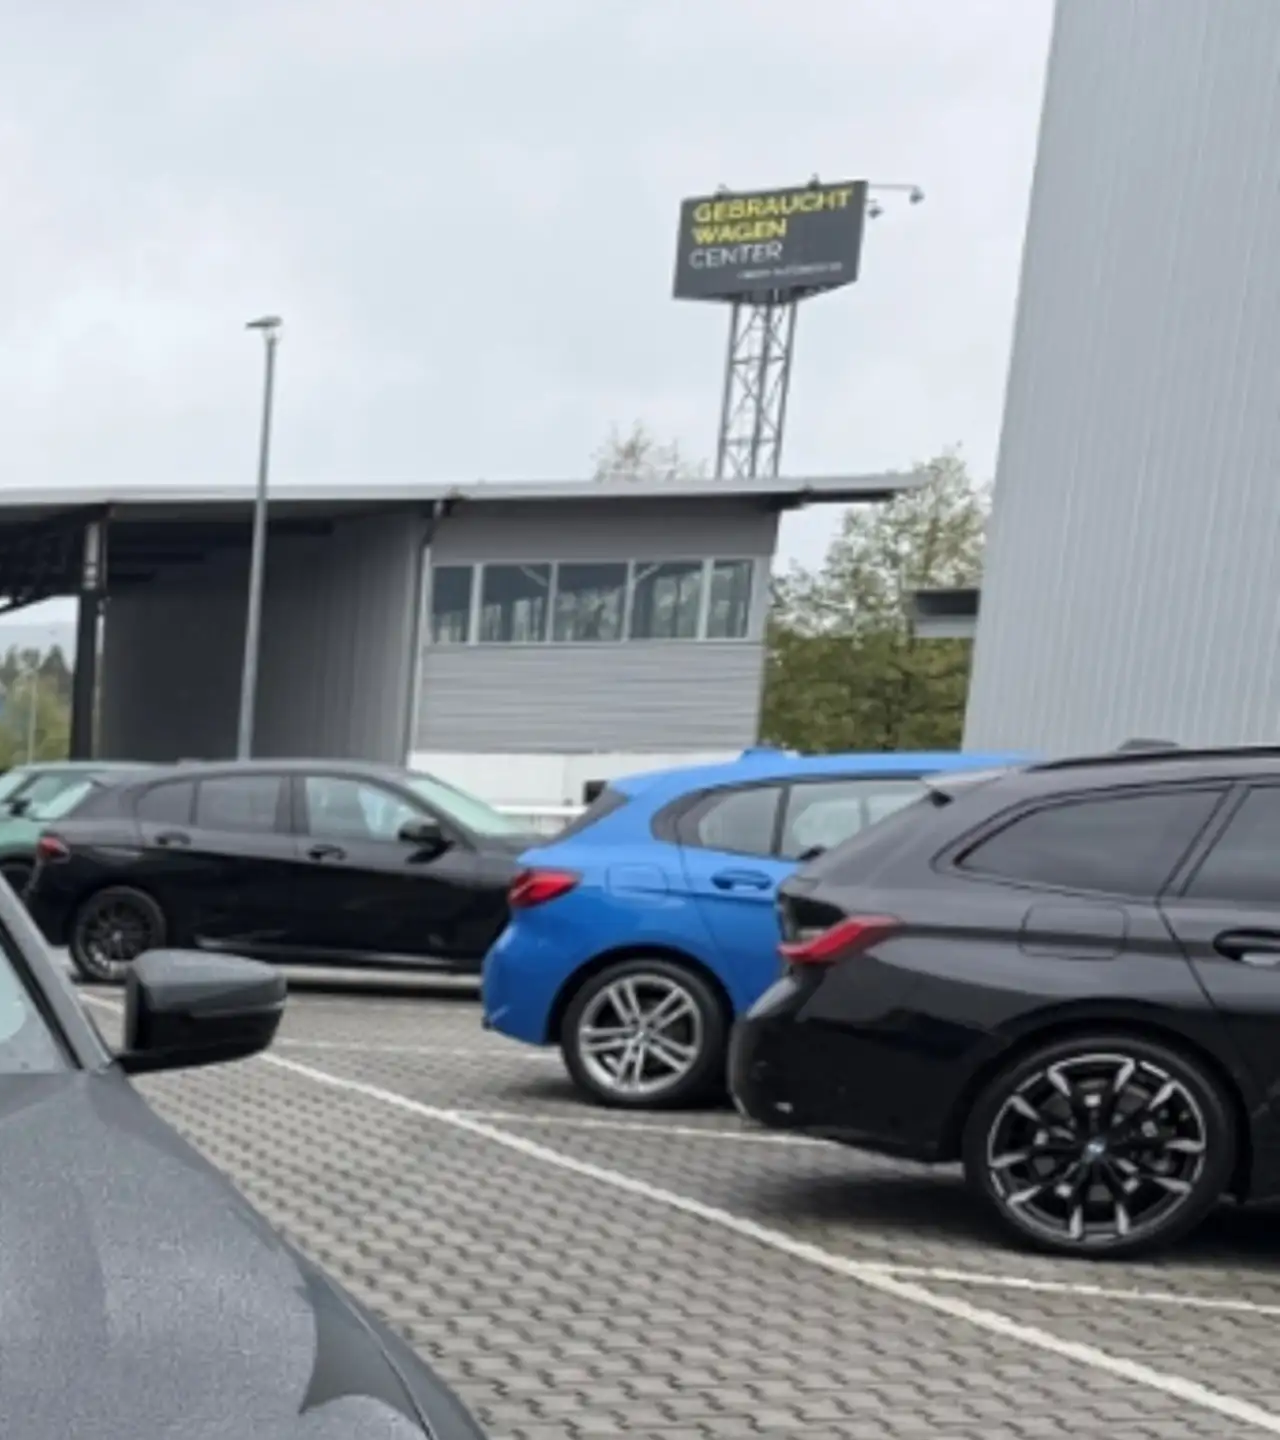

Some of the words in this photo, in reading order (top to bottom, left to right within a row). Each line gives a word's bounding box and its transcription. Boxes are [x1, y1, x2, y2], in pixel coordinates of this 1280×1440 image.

[693, 188, 852, 221] GEBRAUCHT
[692, 219, 786, 244] WAGEN
[690, 241, 783, 268] CENTER
